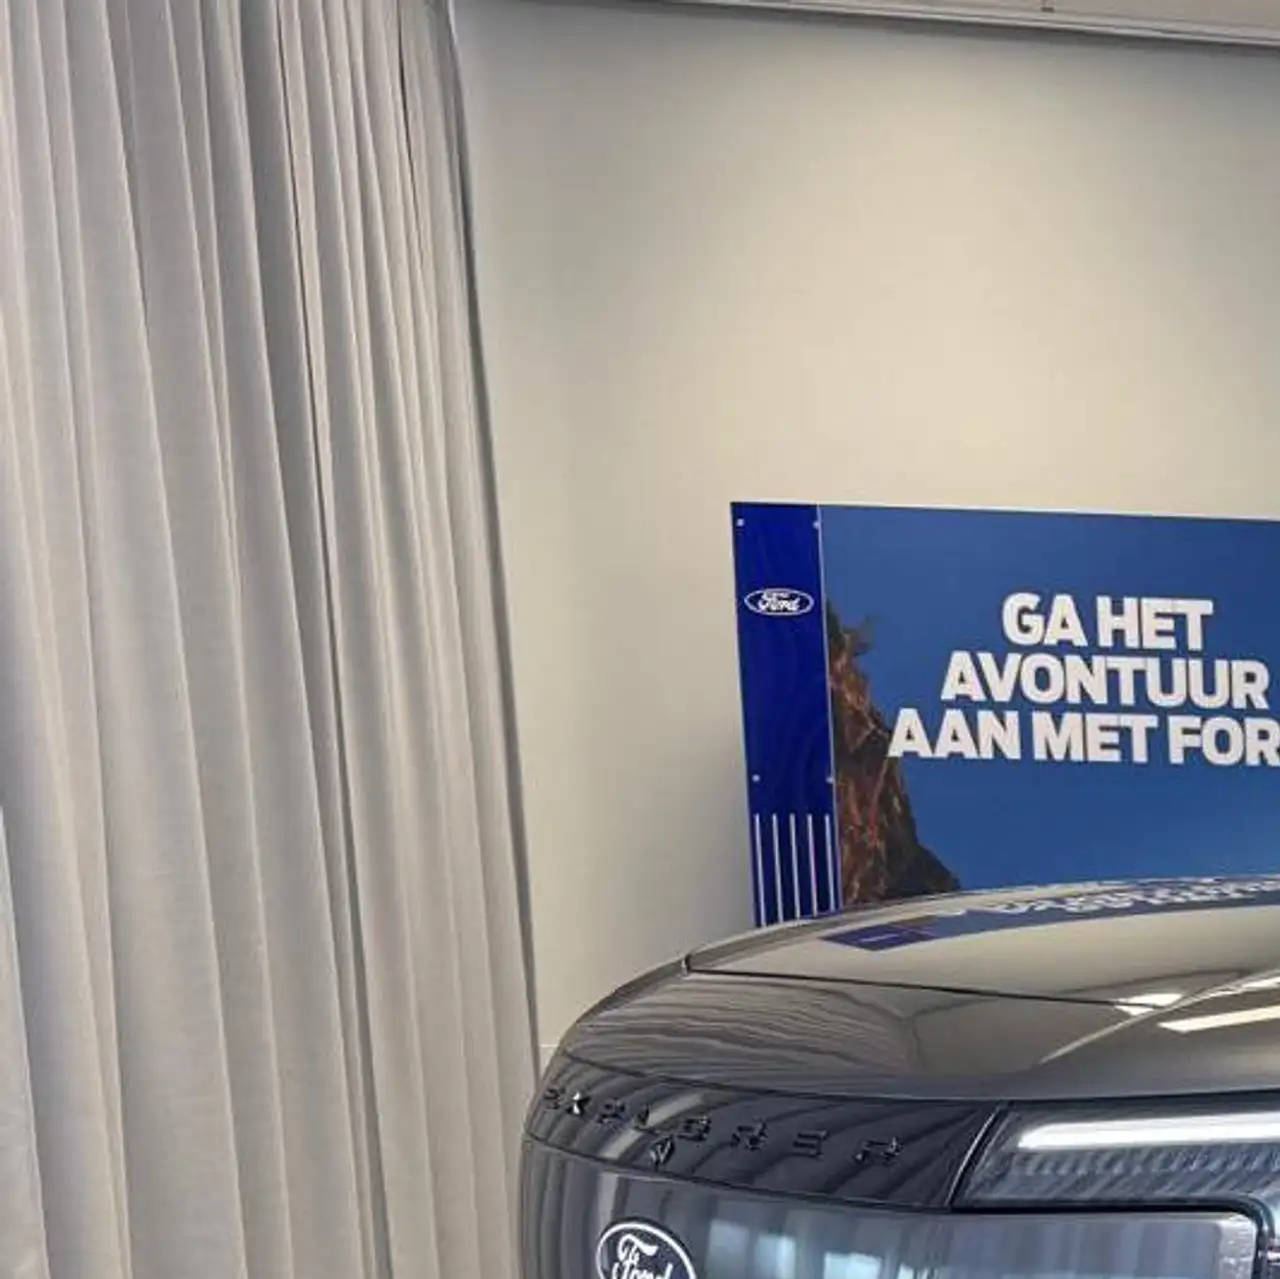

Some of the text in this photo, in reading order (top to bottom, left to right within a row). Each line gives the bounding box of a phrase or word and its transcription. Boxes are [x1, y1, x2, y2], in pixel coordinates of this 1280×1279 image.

[1002, 592, 1214, 651] GA HET
[940, 650, 1270, 710] AVONTUUR
[887, 708, 1021, 760] AAN
[1031, 711, 1158, 763] MET
